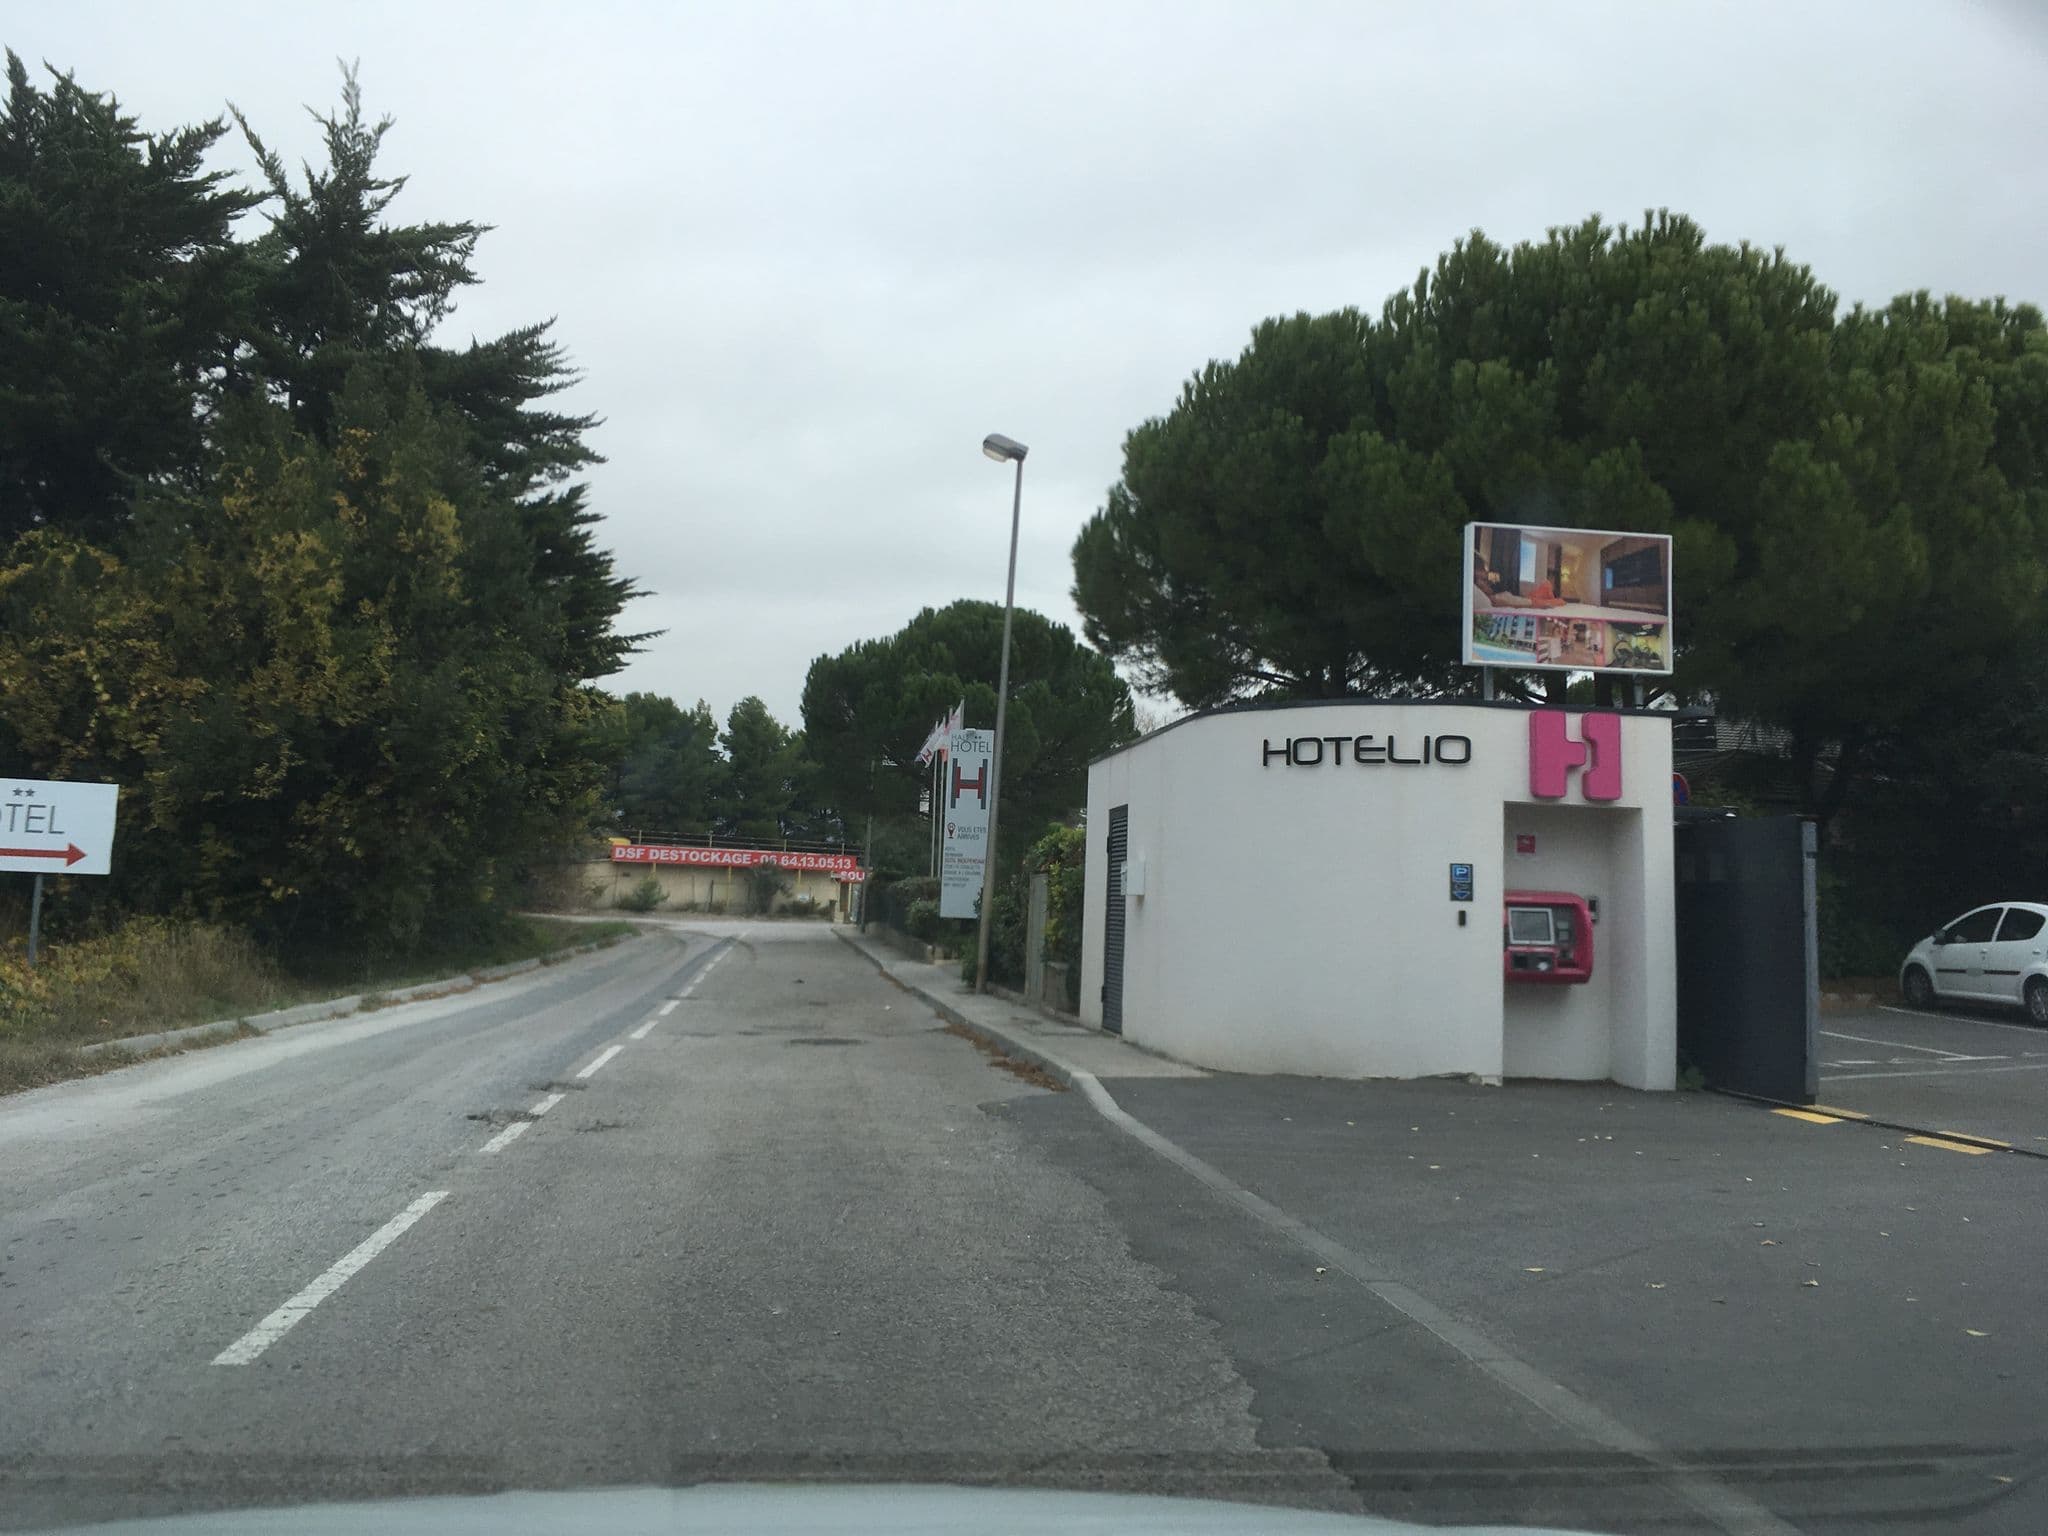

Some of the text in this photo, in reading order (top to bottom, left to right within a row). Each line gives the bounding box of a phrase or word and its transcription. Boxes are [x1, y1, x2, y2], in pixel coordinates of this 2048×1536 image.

[951, 740, 992, 753] HOTEL
[1263, 735, 1471, 767] HOTELIO
[0, 803, 65, 834] TEL
[615, 847, 646, 860] DSF
[649, 848, 752, 865] DESTOCKAGE
